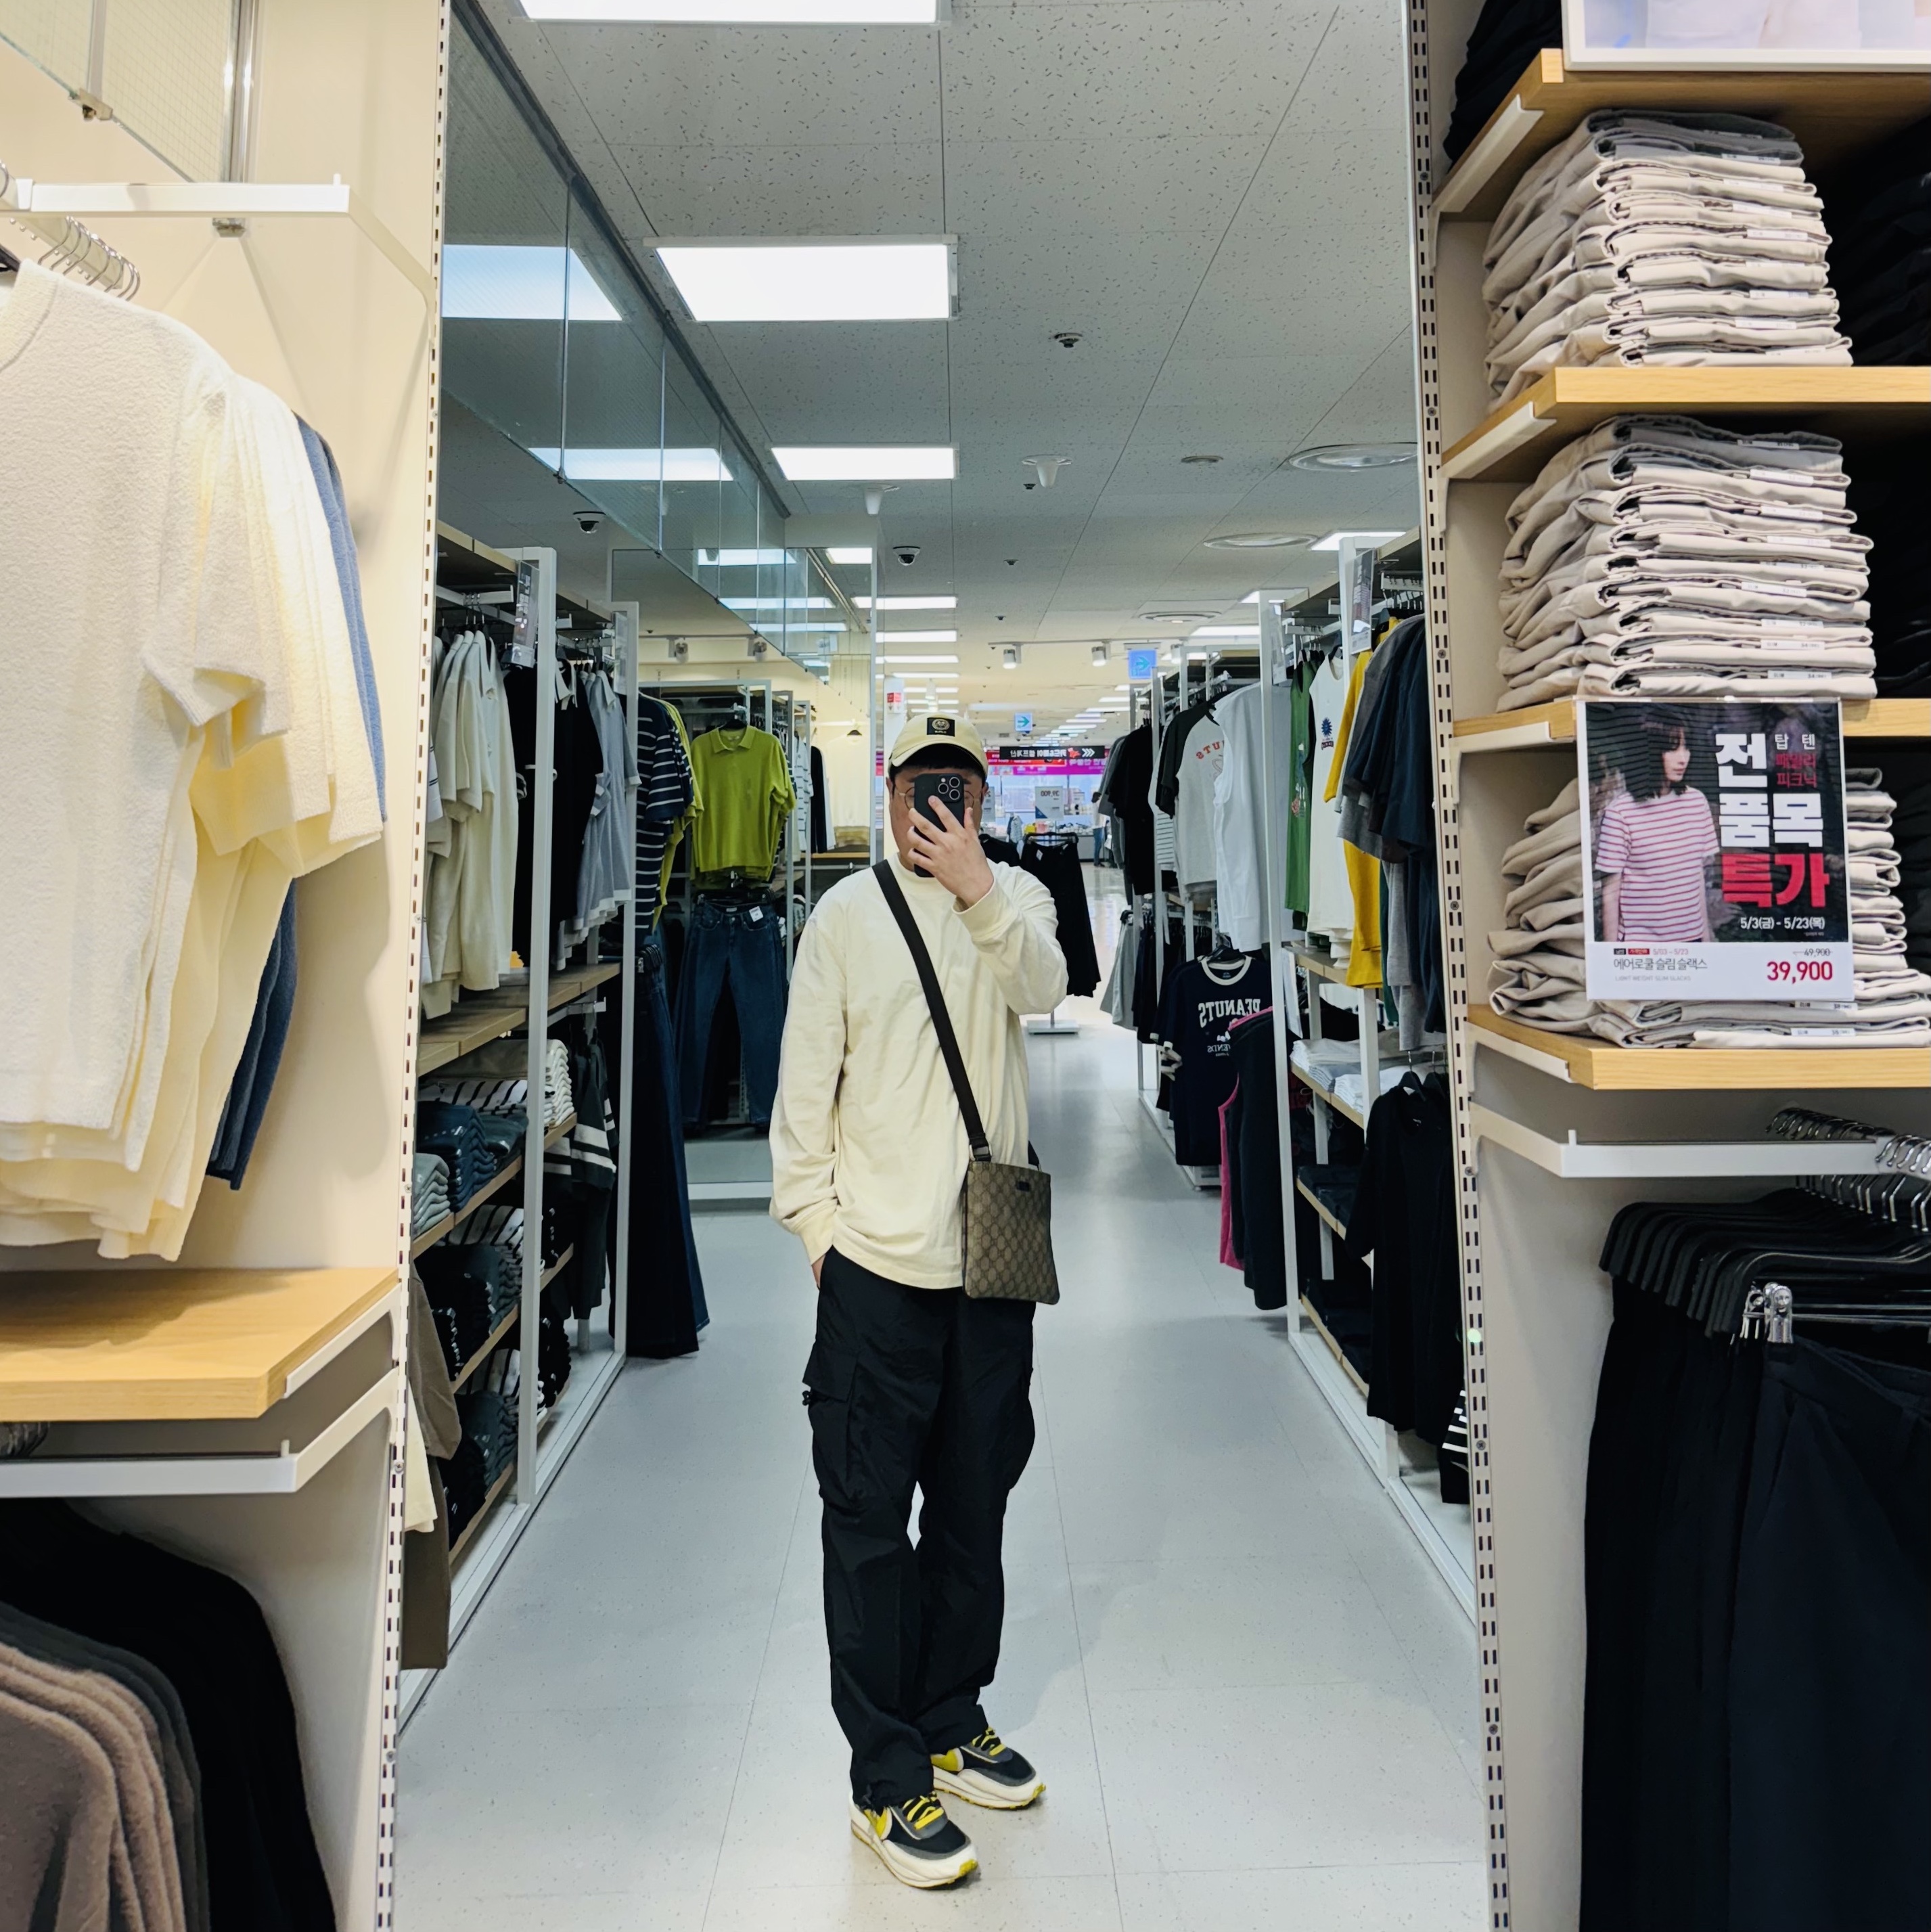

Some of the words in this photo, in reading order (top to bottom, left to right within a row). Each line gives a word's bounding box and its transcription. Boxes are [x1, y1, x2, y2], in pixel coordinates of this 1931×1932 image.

[1719, 793, 1823, 847] 품목
[1721, 853, 1830, 907] 특가
[1740, 916, 1775, 929] 5/3(금)
[1784, 916, 1825, 930] 5/23(목)
[1804, 948, 1832, 958] 49,900
[1614, 958, 1653, 970] 에어로쿨
[1656, 958, 1675, 970] 슬림
[1677, 958, 1708, 970] 슬랙스
[1767, 961, 1833, 984] 39,900
